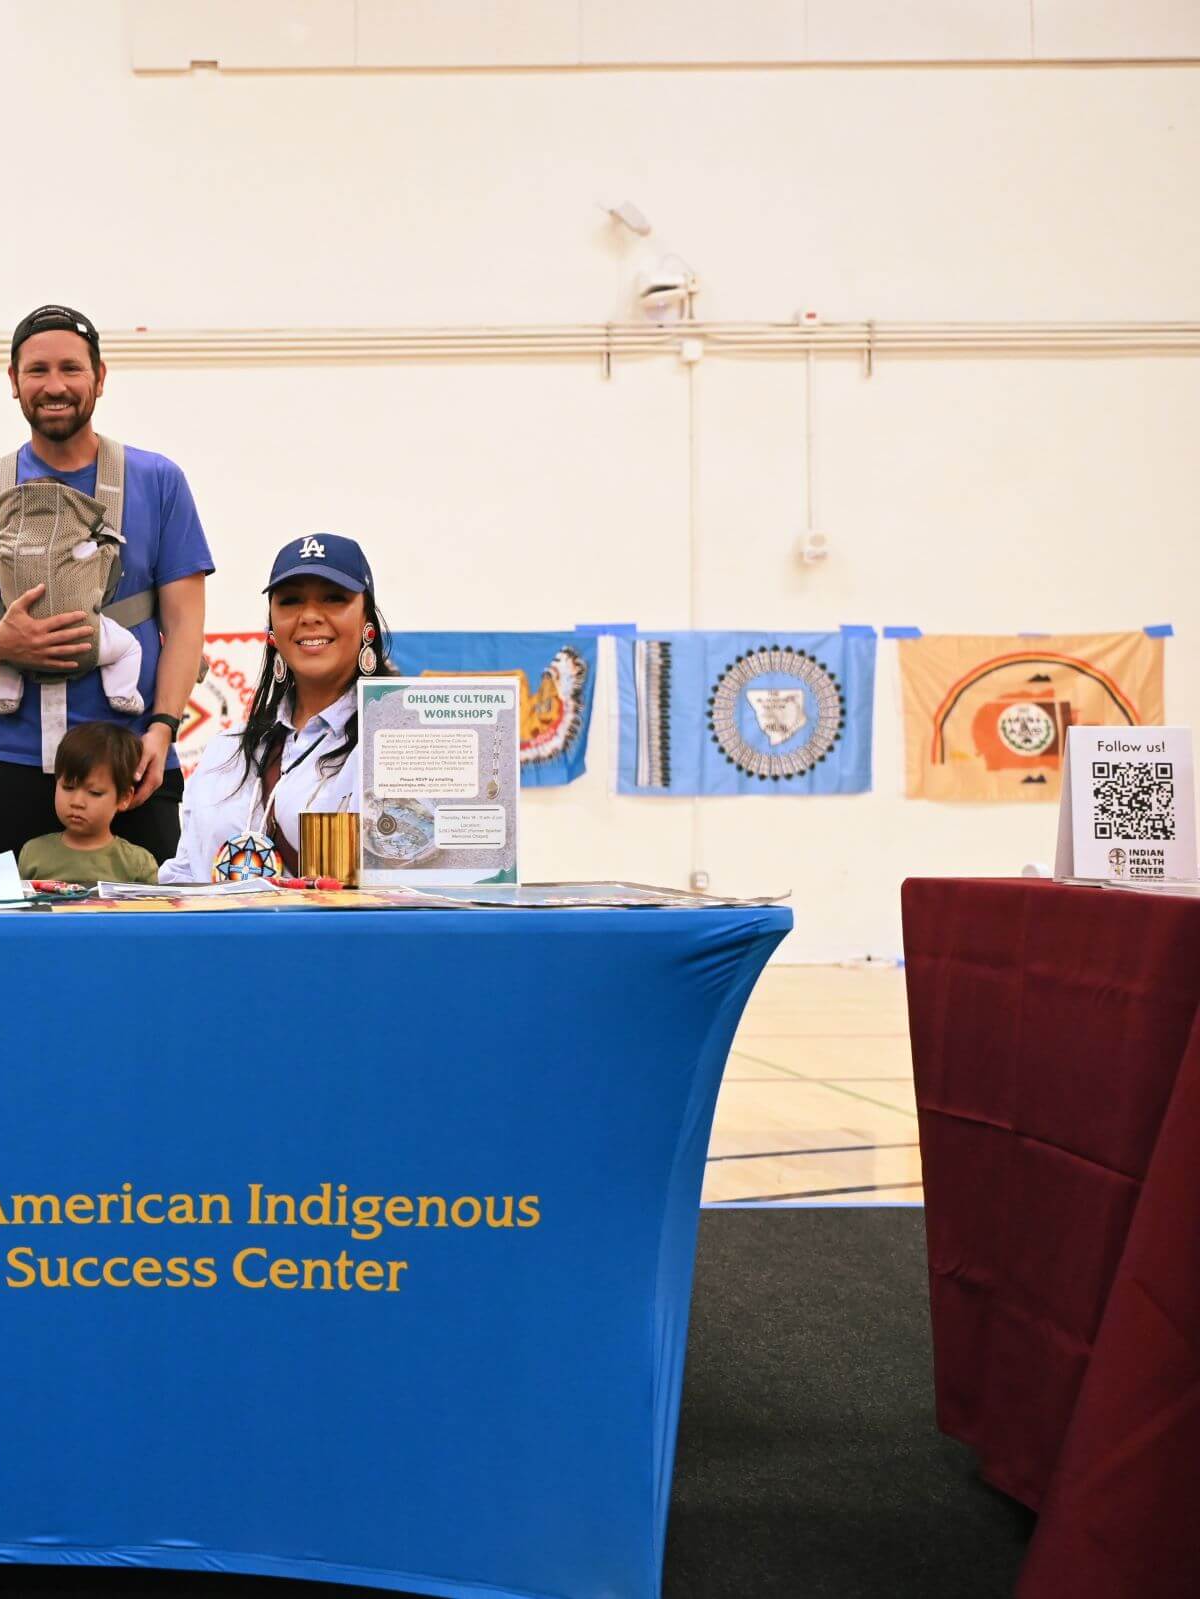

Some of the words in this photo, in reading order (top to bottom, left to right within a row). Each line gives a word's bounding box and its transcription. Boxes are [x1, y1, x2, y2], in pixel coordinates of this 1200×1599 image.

[299, 536, 326, 559] LA
[407, 694, 450, 704] OHLONE
[453, 694, 506, 704] CULTURAL
[424, 709, 493, 718] WORKSHOPS
[1097, 740, 1142, 752] Follow
[1146, 741, 1166, 752] us!
[249, 1183, 541, 1240] Indigenous
[7, 1248, 217, 1289] Success
[232, 1247, 408, 1291] Center
